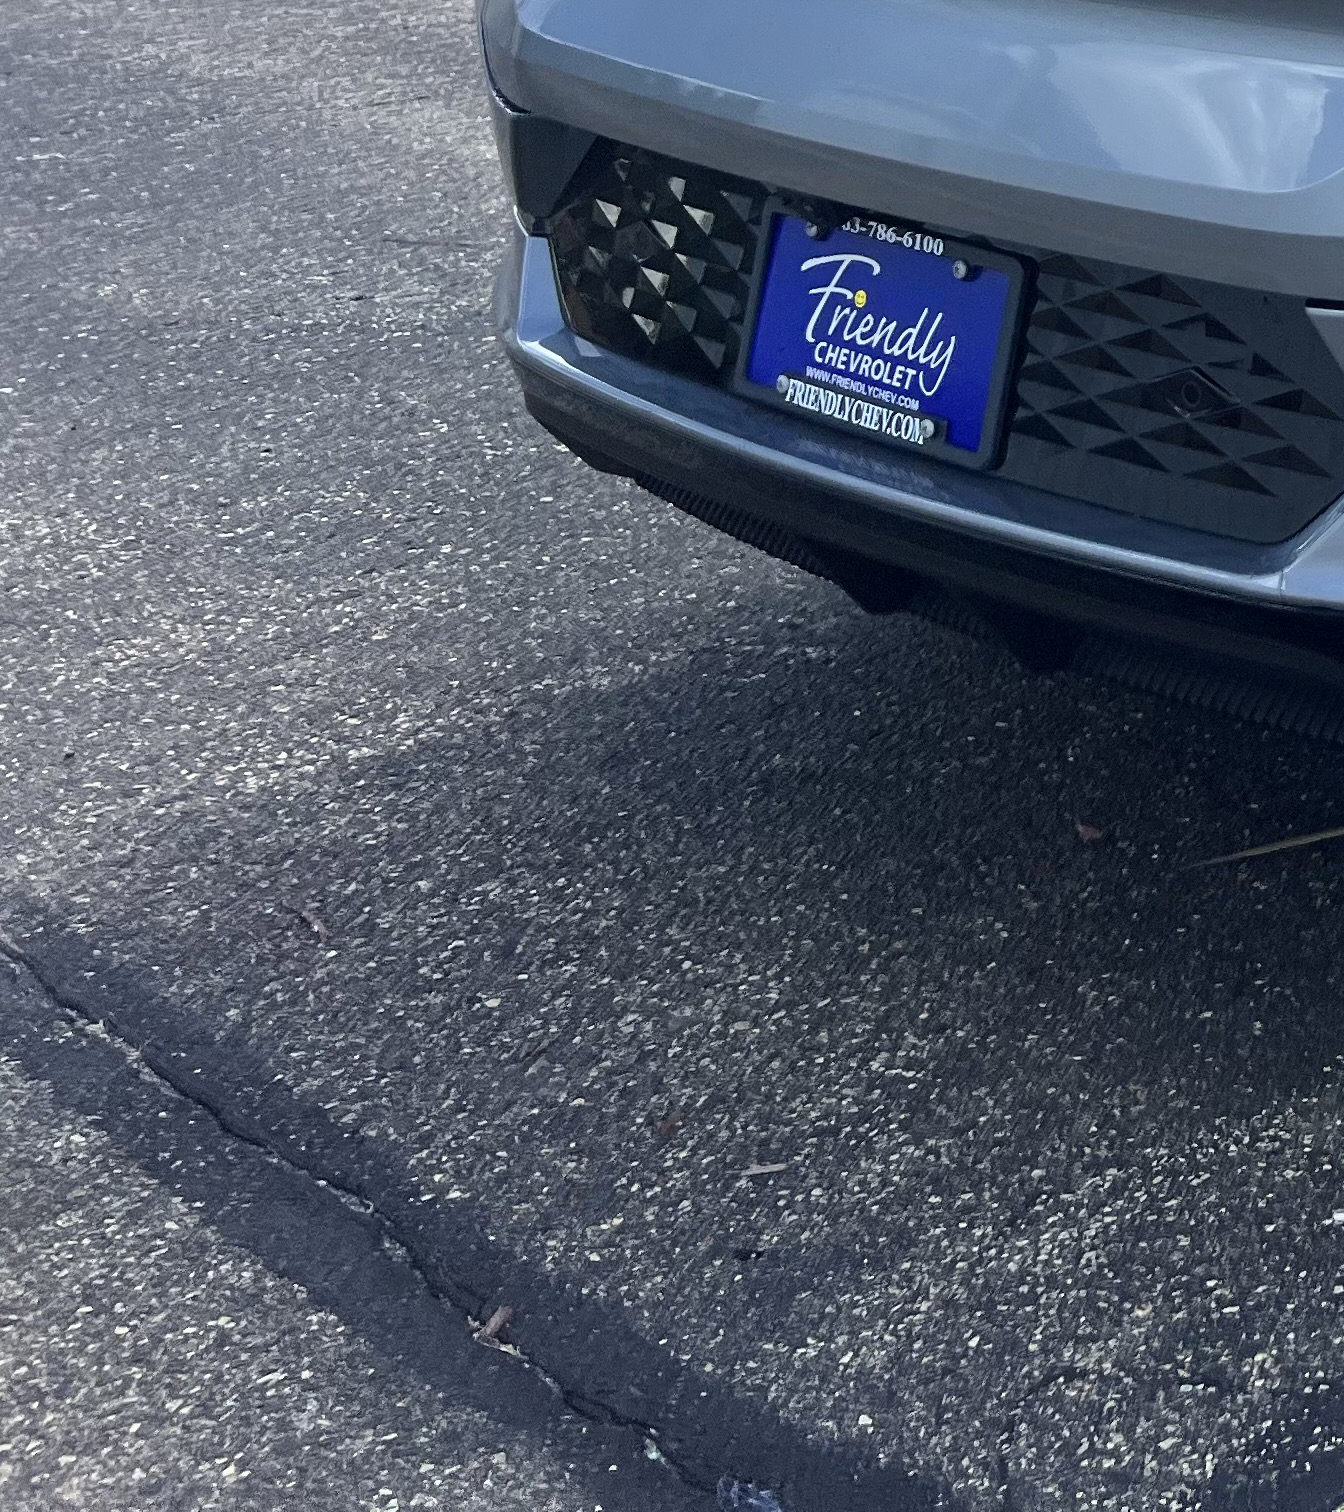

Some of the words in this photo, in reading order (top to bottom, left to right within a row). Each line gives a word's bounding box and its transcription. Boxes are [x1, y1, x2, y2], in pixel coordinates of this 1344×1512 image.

[801, 254, 956, 396] Friendly
[806, 366, 919, 411] WWW.FRIENDLYCHEV.COM
[814, 341, 917, 390] CHEVROLET
[785, 378, 923, 445] FRIENDLYCHEV.COM
